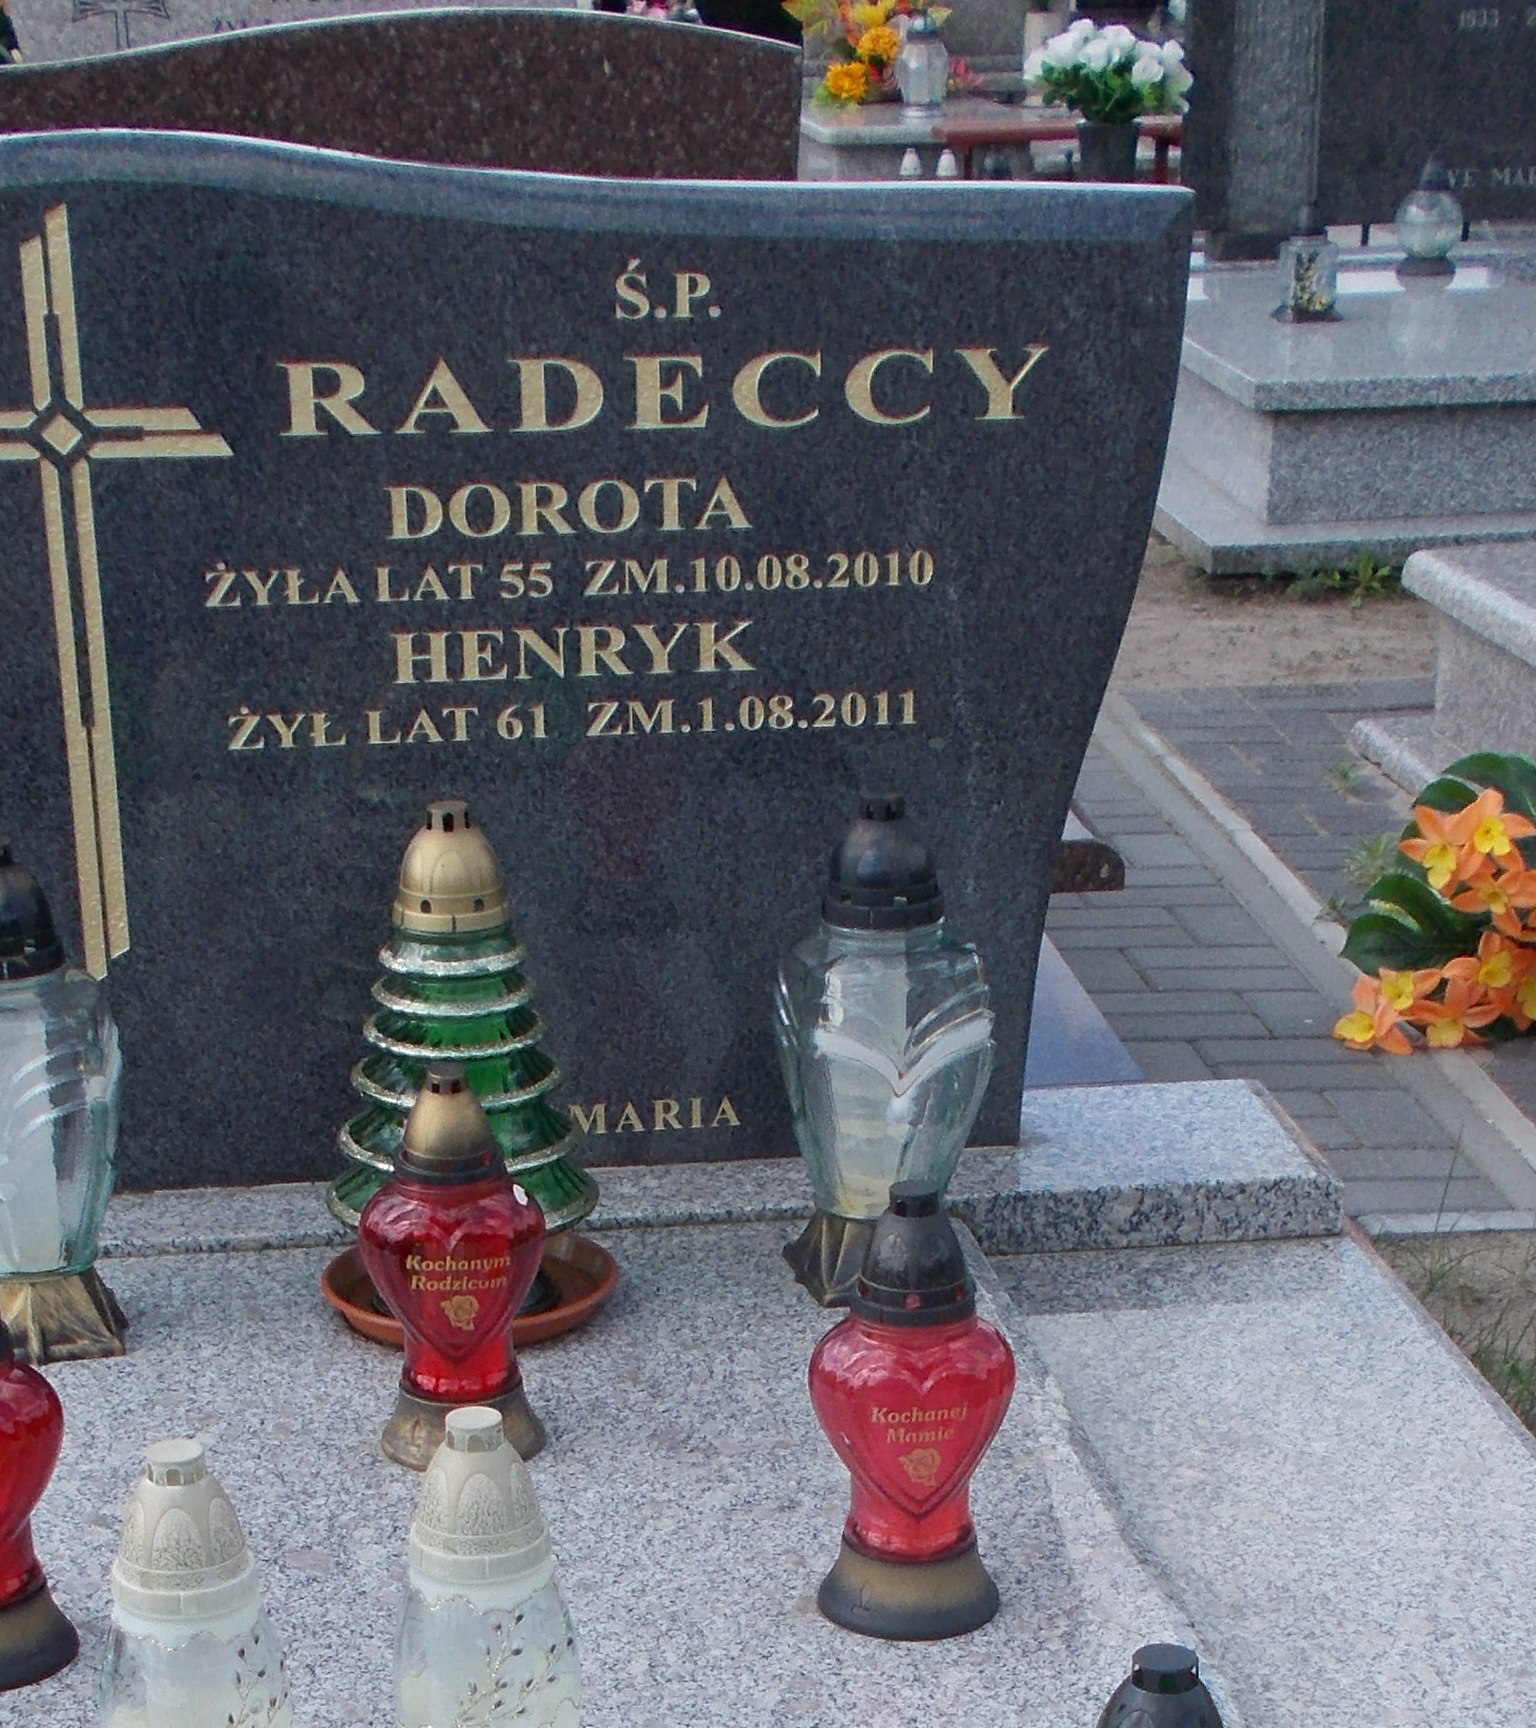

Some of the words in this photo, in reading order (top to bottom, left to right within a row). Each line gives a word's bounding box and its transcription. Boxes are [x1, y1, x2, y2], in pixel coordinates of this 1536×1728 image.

[1444, 167, 1479, 190] VE
[615, 257, 722, 320] Ś.P.
[275, 342, 1051, 436] RADECCY
[383, 475, 753, 540] DOROTA
[203, 562, 362, 608] ŻYŁA
[374, 563, 484, 602] LAT
[498, 561, 554, 599] 55
[389, 619, 758, 684] HENRYK
[226, 704, 347, 751] ŻYŁ
[365, 705, 479, 745] LAT
[496, 702, 549, 741] 61
[568, 1096, 742, 1135] MARIA
[404, 1253, 513, 1276] Kochanym
[870, 1402, 968, 1424] Kochanej
[885, 1426, 955, 1444] Mamie
